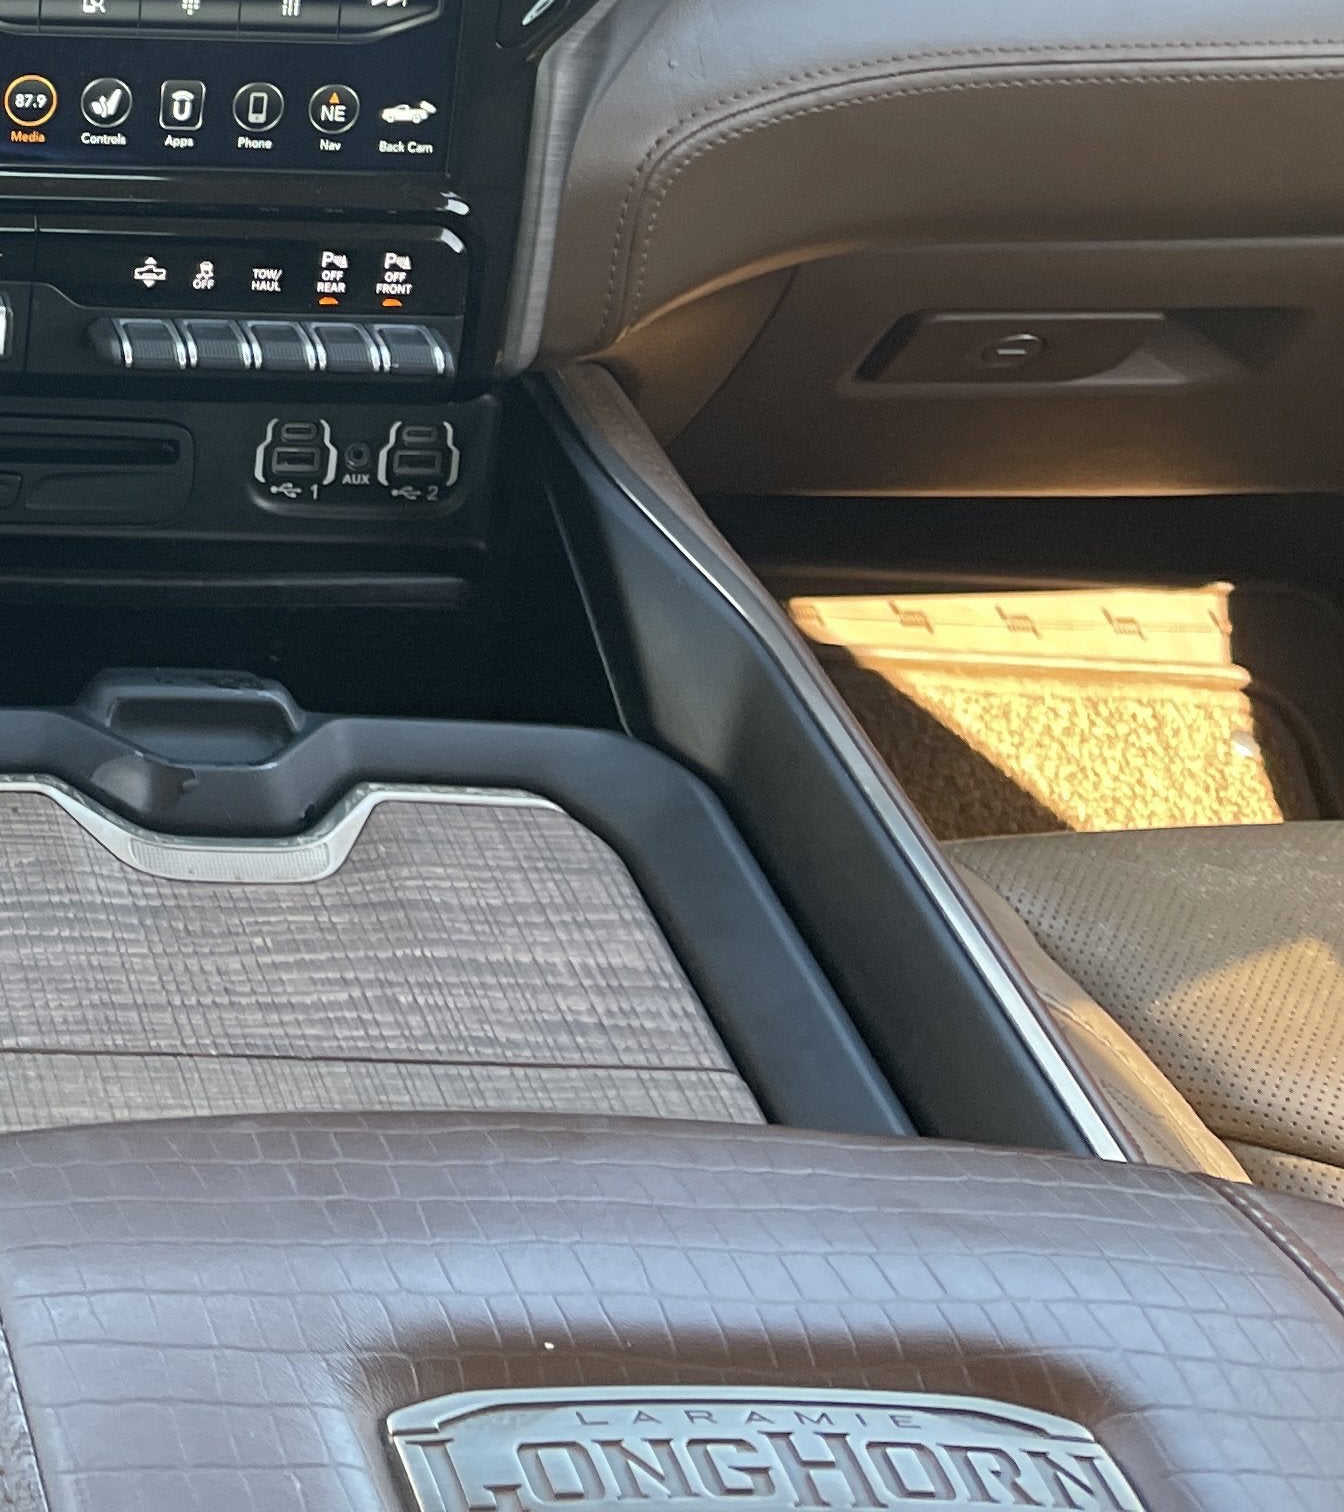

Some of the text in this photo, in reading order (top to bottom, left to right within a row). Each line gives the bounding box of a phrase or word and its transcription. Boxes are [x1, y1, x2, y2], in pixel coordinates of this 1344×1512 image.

[15, 93, 46, 109] 87.9
[321, 105, 346, 122] NE
[11, 131, 45, 144] Media
[81, 132, 126, 146] Controls
[165, 135, 193, 148] Apps
[237, 136, 272, 150] Phone
[320, 139, 341, 151] Nav
[379, 140, 433, 154] Back Cam
[252, 268, 282, 280] TOW/
[321, 270, 344, 281] OFF
[384, 272, 407, 283] OFF
[193, 279, 215, 289] OFF
[251, 280, 282, 292] HAUL
[316, 282, 346, 293] REAR
[376, 284, 412, 295] FRONT
[342, 474, 370, 485] AUX
[310, 484, 318, 500] 1
[427, 486, 439, 501] 2
[576, 1409, 923, 1430] LARAMIE
[408, 1431, 1144, 1512] LONGHORN
